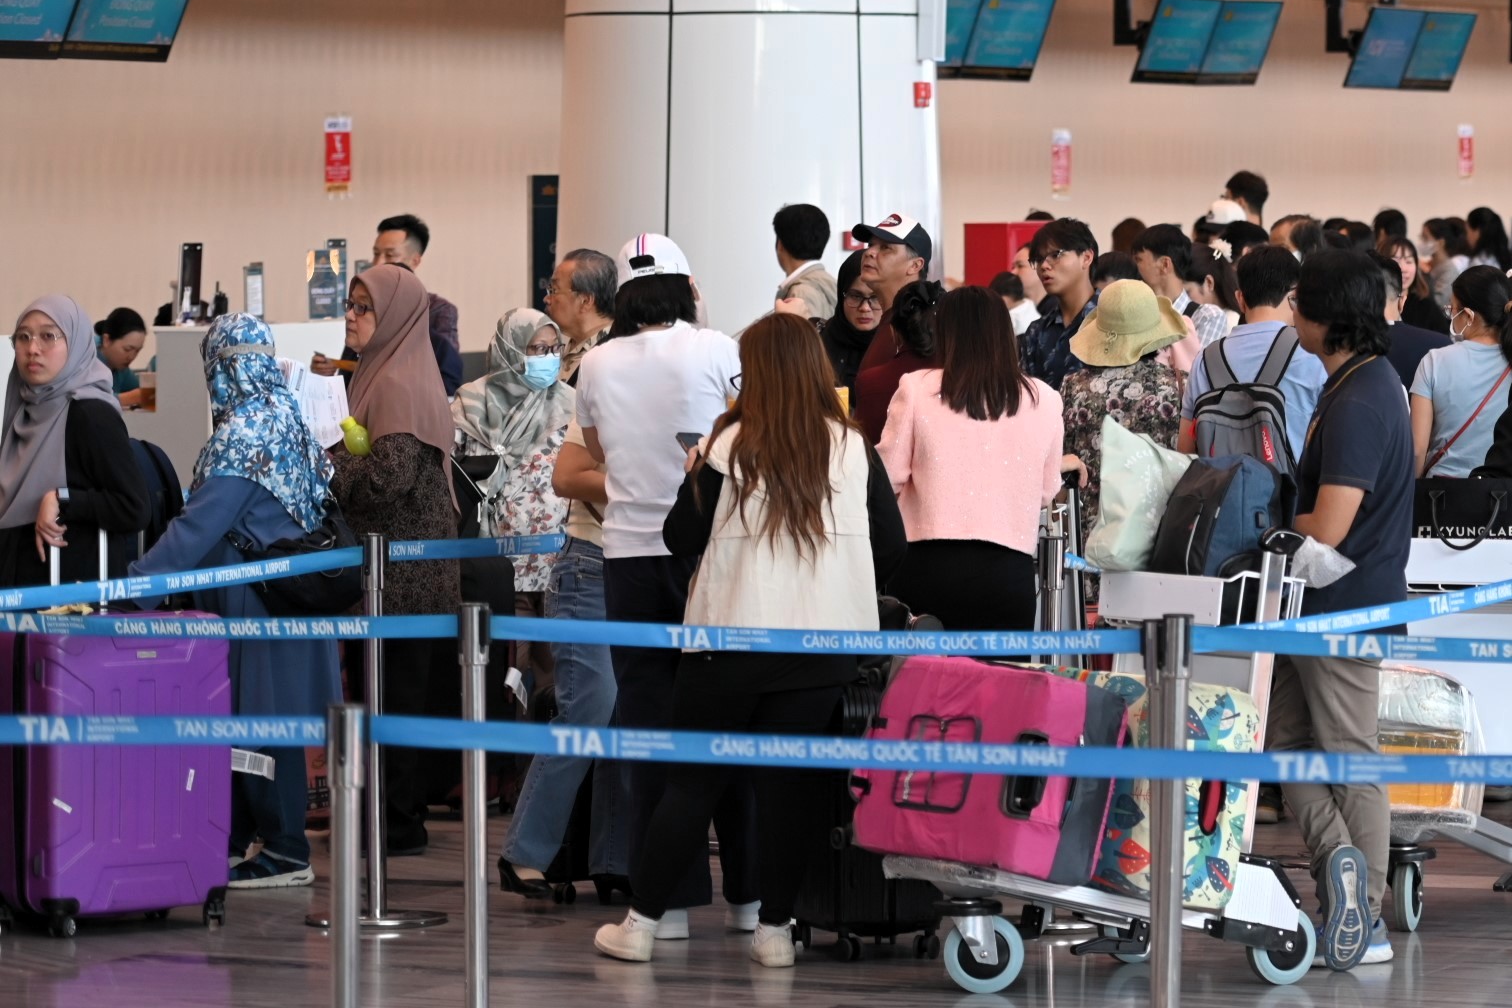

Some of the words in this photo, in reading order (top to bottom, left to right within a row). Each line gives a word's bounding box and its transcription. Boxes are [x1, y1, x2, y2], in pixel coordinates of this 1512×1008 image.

[496, 538, 516, 554] TIA
[166, 577, 180, 588] TAN
[181, 575, 195, 587] SON
[195, 572, 213, 584] NHAT
[214, 565, 262, 581] INTERNATIONAL
[264, 560, 290, 574] AIRPORT
[97, 581, 127, 601] TIA
[1429, 595, 1449, 615] TIA
[666, 626, 711, 649] TIA
[1322, 634, 1383, 657] TIA
[1470, 643, 1499, 657] TAN
[19, 716, 71, 742] TIA
[175, 720, 209, 736] TAN
[210, 721, 250, 737] SON
[250, 722, 298, 737] NHAT
[552, 729, 605, 755] TIA
[1273, 753, 1330, 780] TIA
[1449, 760, 1487, 777] TAN
